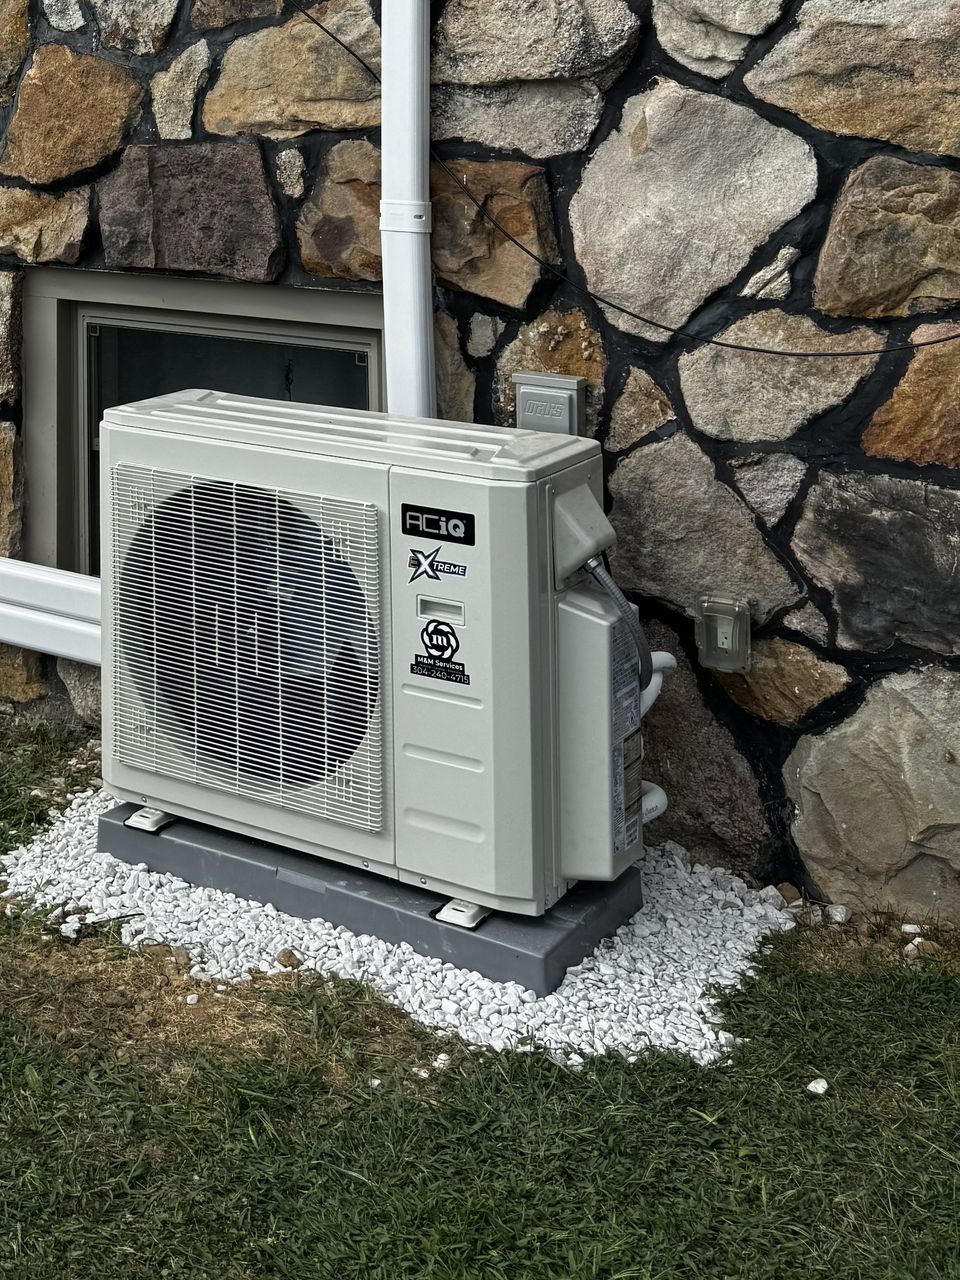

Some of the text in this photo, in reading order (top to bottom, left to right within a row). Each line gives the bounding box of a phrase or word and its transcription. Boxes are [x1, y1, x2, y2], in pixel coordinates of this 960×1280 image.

[417, 656, 434, 665] M&M
[435, 659, 463, 671] Services
[412, 665, 469, 684] 304-240-4715
